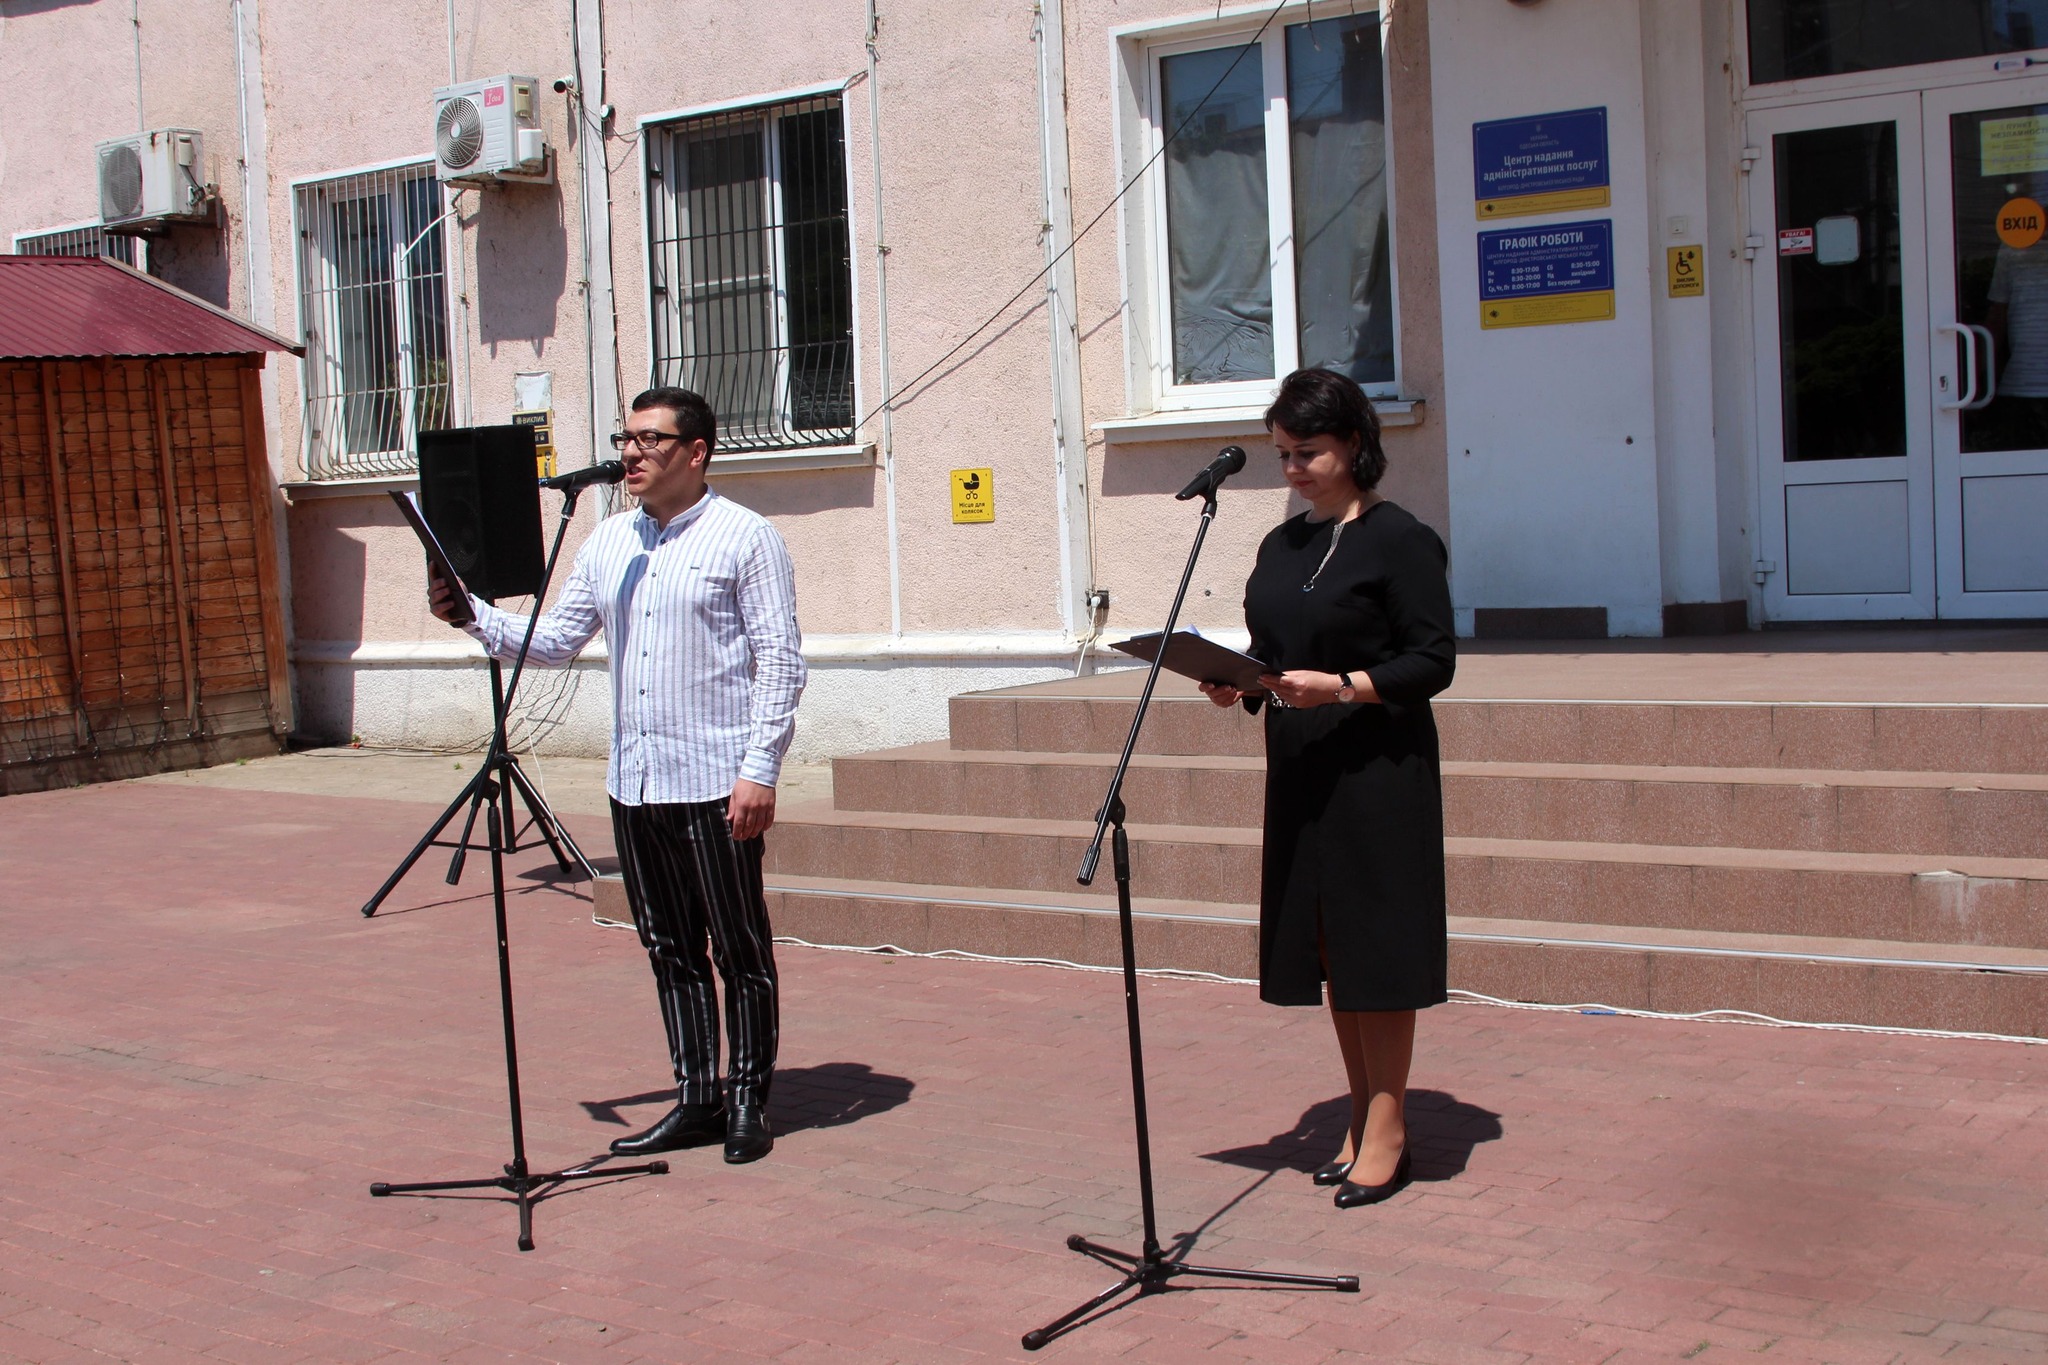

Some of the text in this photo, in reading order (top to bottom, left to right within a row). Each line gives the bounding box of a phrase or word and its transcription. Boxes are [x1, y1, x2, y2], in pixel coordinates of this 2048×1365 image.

[1503, 149, 1573, 167] Центр надання
[1483, 160, 1598, 182] адміністративних послуг
[2003, 216, 2038, 231] ВХІД
[1499, 231, 1583, 251] ГРАФІК РОБОТИ
[1511, 266, 1539, 275] 8:30-17:00
[1511, 273, 1541, 283] 8:30-20:00
[1511, 281, 1540, 291] 8:00-17:00
[1673, 282, 1699, 290] ДОПОМОГИ
[522, 415, 545, 425] ВИКЛИК
